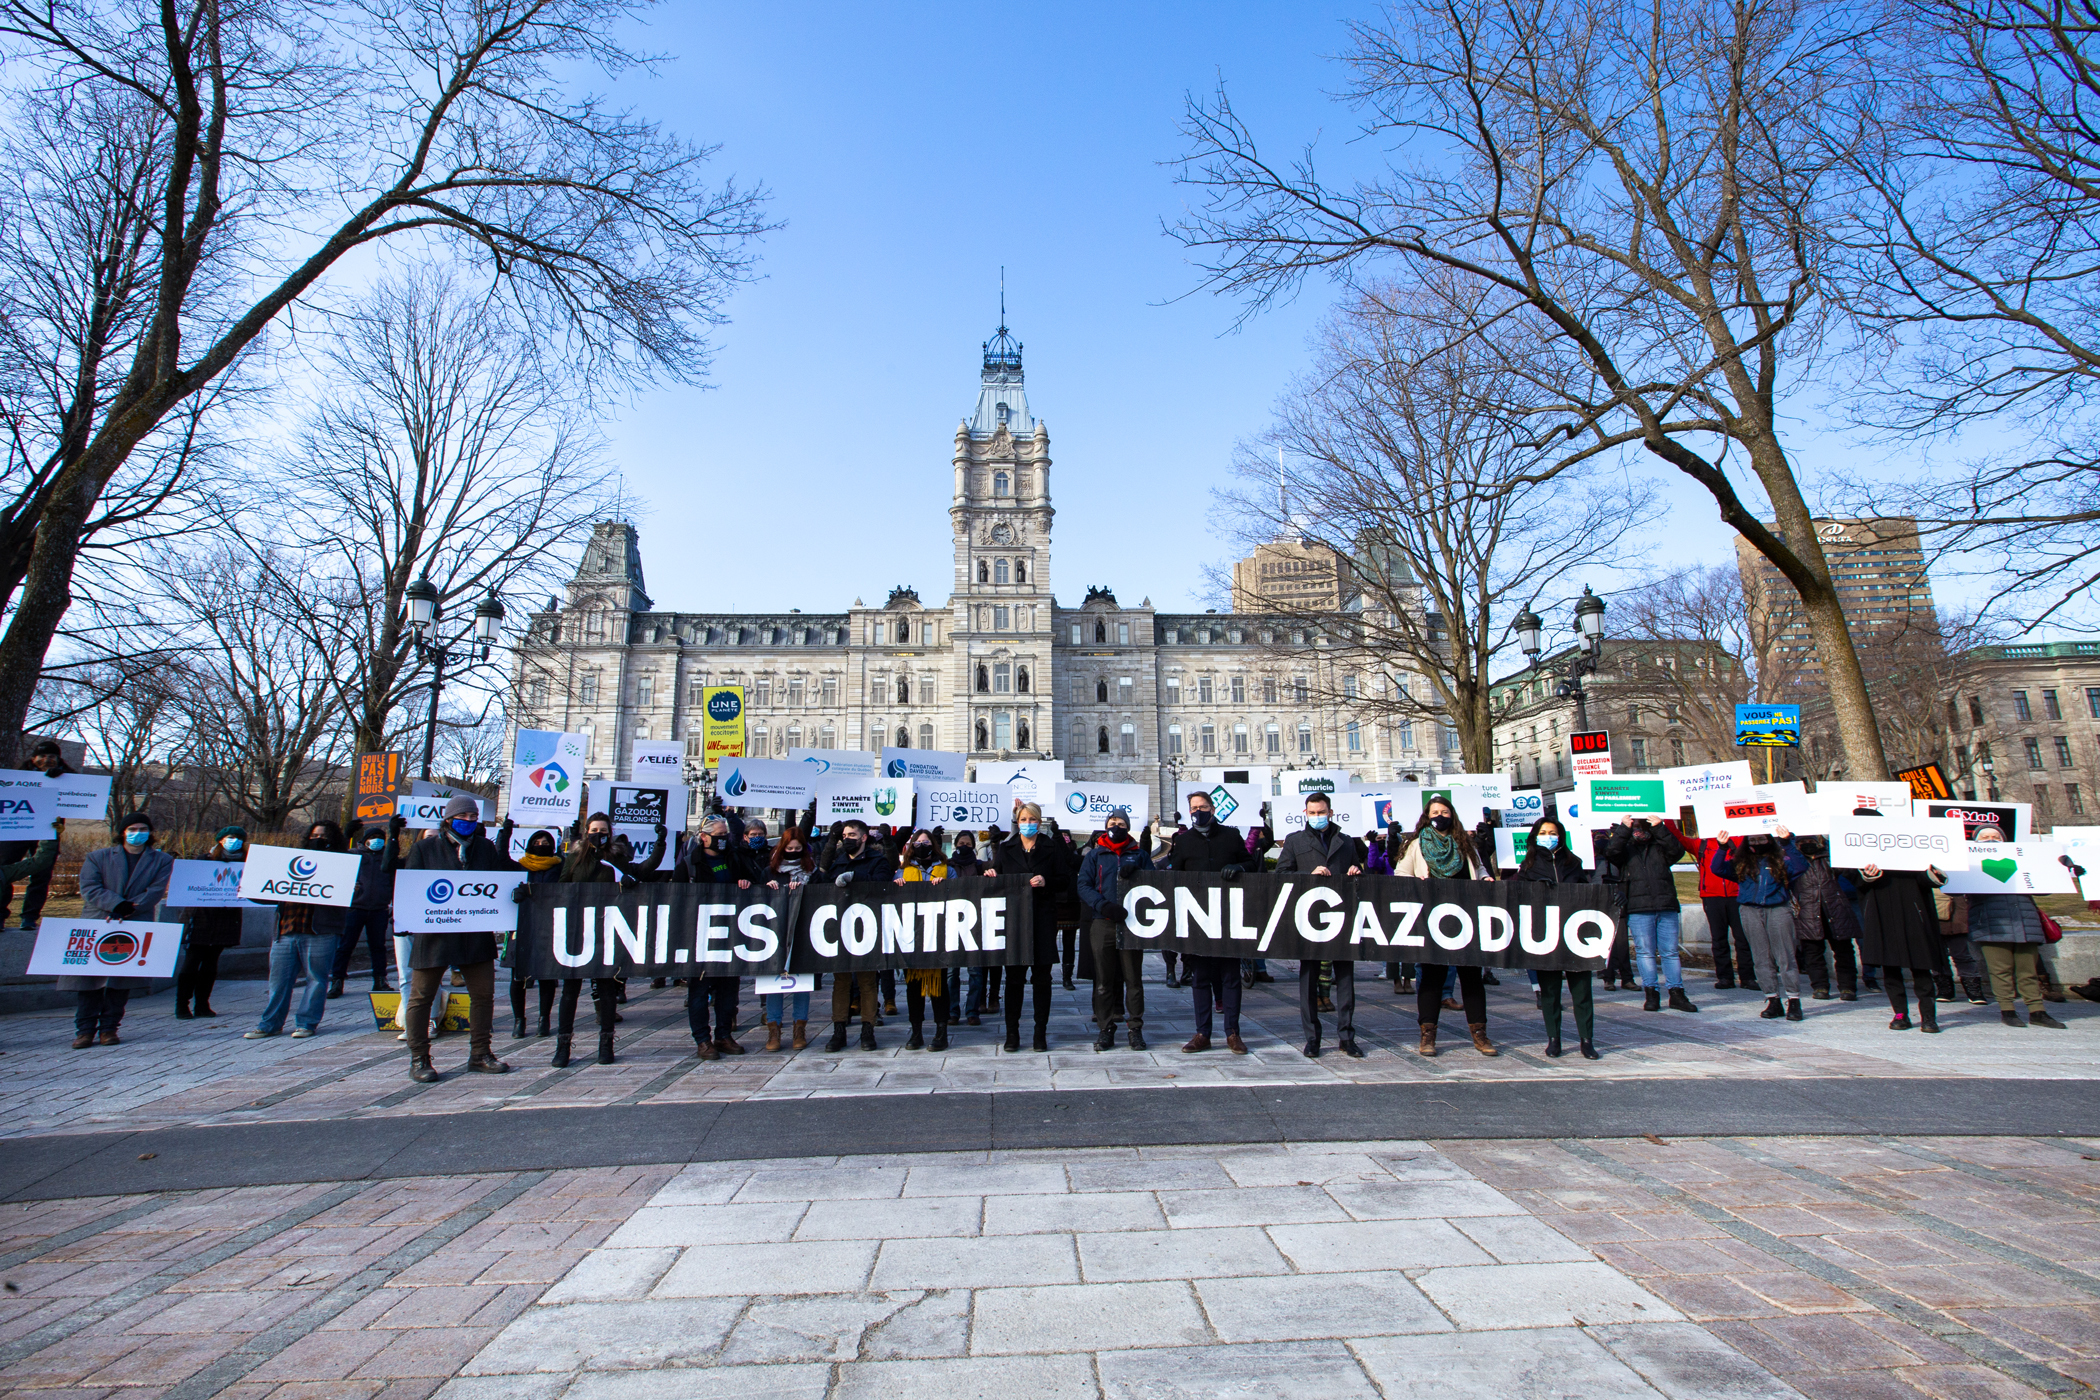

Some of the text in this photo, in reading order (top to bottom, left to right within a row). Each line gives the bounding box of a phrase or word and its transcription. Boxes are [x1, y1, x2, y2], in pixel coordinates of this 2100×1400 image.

[1744, 711, 1772, 719] VOUS
[707, 741, 721, 750] UNE
[1573, 734, 1607, 751] DUC
[362, 754, 386, 763] COULE
[360, 762, 385, 776] PAS
[360, 775, 384, 785] CHEZ
[1899, 768, 1926, 782] COULE
[359, 783, 383, 794] NOUS
[521, 795, 571, 807] remdus
[930, 790, 999, 803] coalition
[1090, 795, 1109, 803] EAU
[1728, 805, 1774, 816] ACTES
[614, 815, 661, 823] PARLONS-EN
[1845, 832, 1949, 853] mepacq
[2016, 847, 2024, 857] au
[2022, 872, 2035, 889] front
[260, 879, 334, 899] AGEECC
[457, 883, 499, 899] CSQ
[469, 908, 499, 916] syndicats
[70, 928, 97, 938] COULE
[552, 903, 779, 967] UNI.ES
[810, 897, 1007, 958] CONTRE
[67, 937, 95, 951] PAS
[62, 957, 89, 965] NOUS
